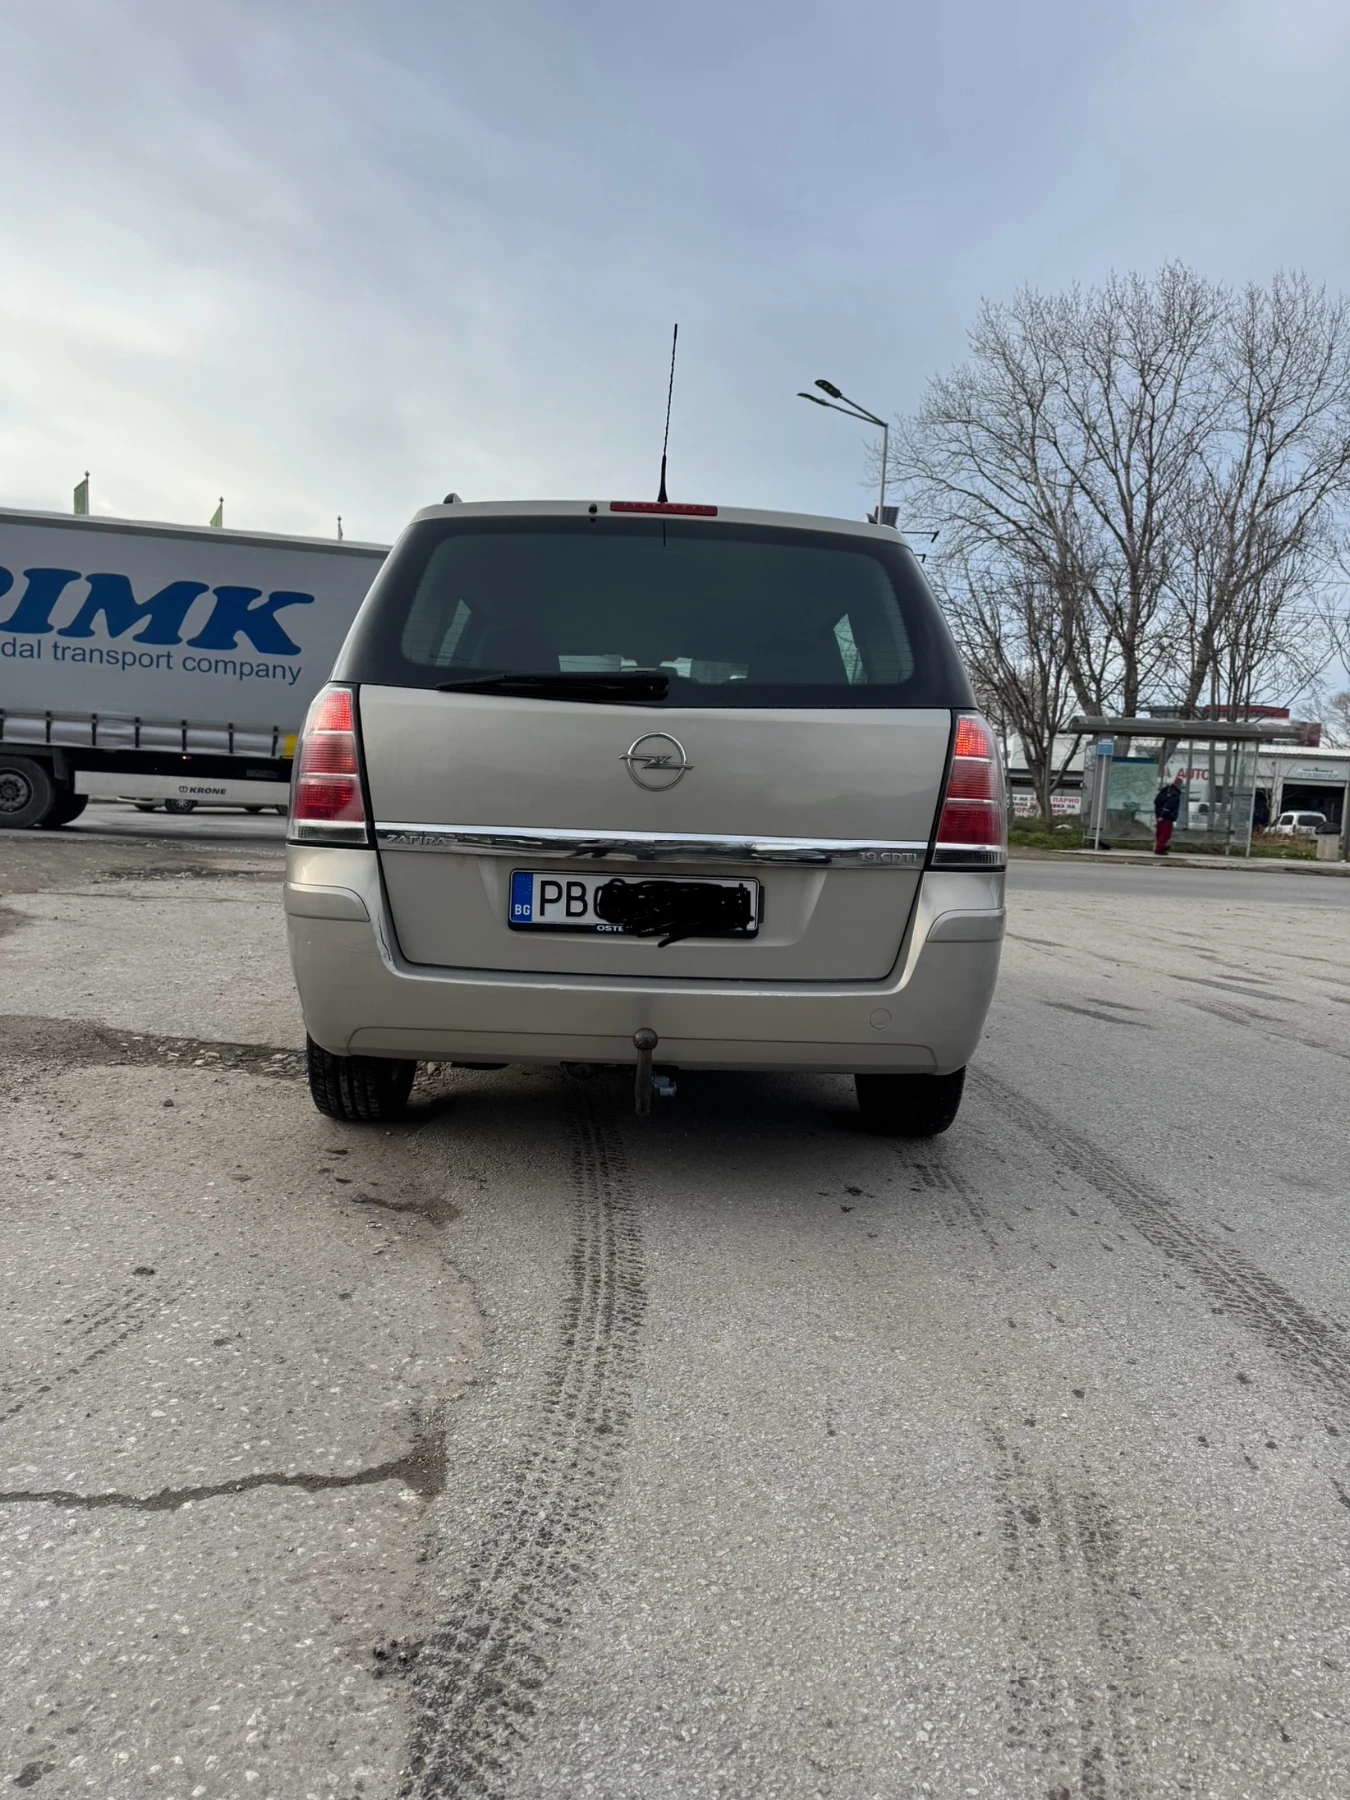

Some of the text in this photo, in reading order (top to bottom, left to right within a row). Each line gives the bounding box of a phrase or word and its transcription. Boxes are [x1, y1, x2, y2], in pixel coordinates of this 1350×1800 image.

[0, 566, 315, 656] IMK
[52, 641, 173, 671] transport
[182, 656, 302, 686] company
[189, 787, 227, 795] KRONE
[387, 834, 449, 846] ZAFIRA
[880, 852, 917, 863] CDTI
[514, 904, 530, 915] BG
